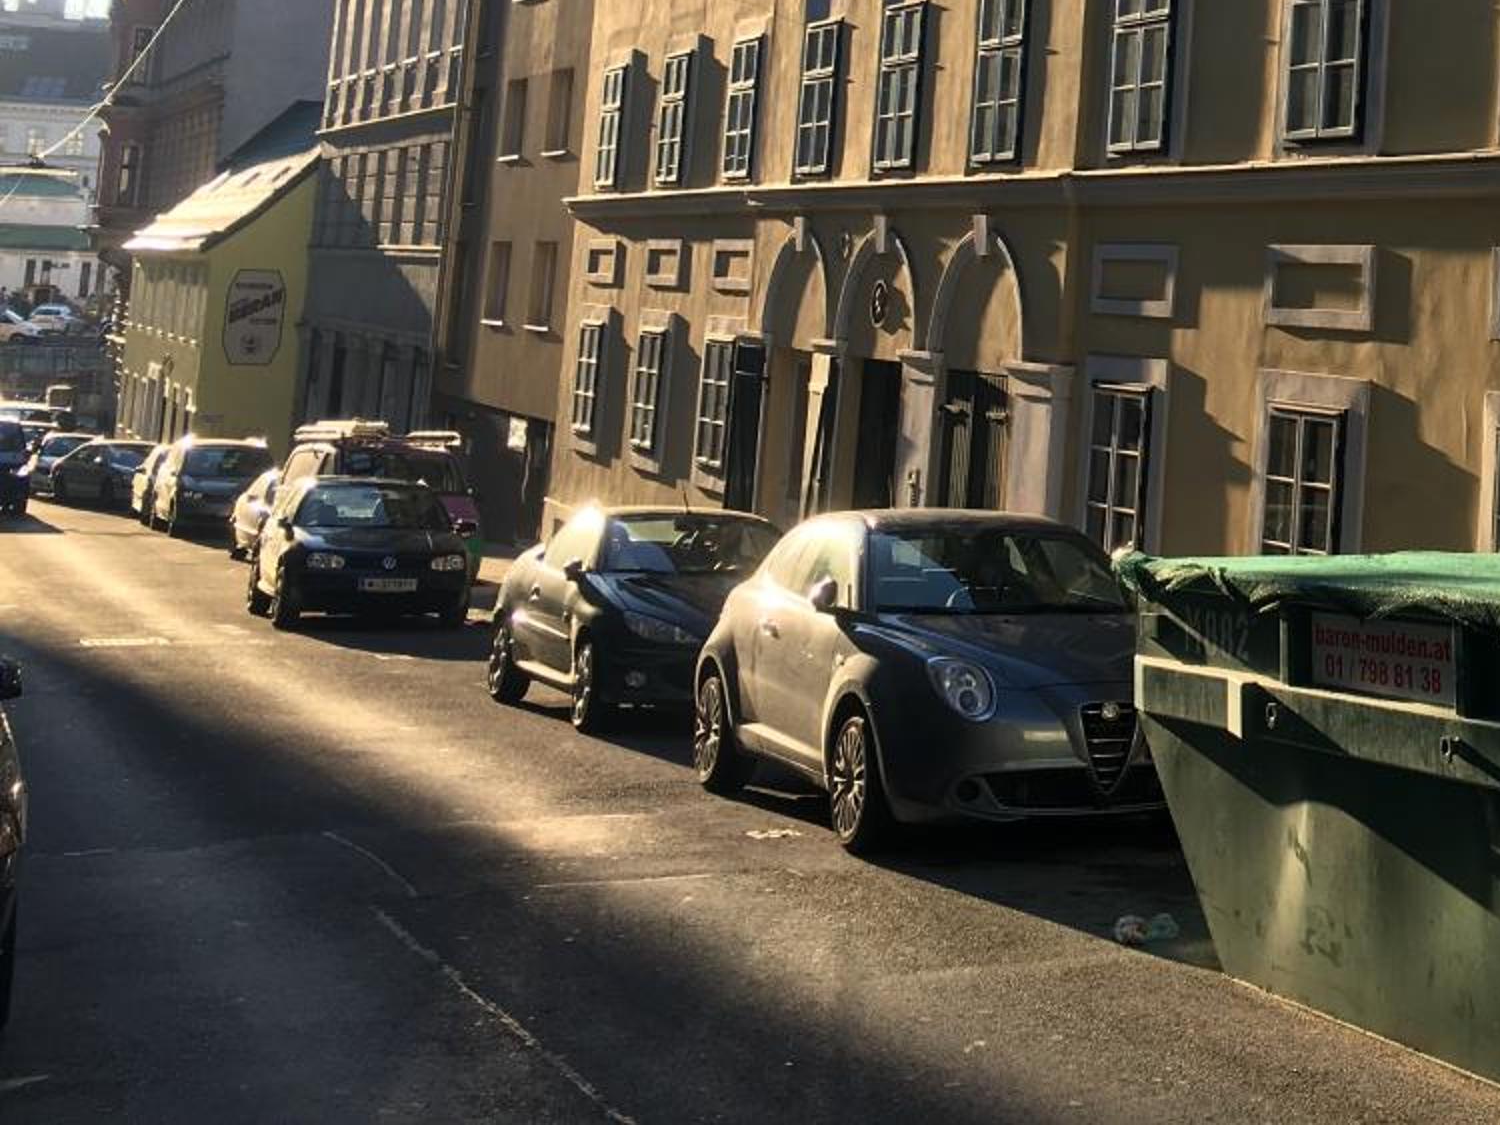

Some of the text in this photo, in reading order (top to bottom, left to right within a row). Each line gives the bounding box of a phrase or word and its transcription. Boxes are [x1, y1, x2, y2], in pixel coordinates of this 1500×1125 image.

[1314, 624, 1450, 662] baron-mulden.at
[1326, 655, 1343, 679] 01
[1359, 657, 1388, 685] 798
[1393, 664, 1414, 690] 81
[1420, 666, 1441, 694] 38
